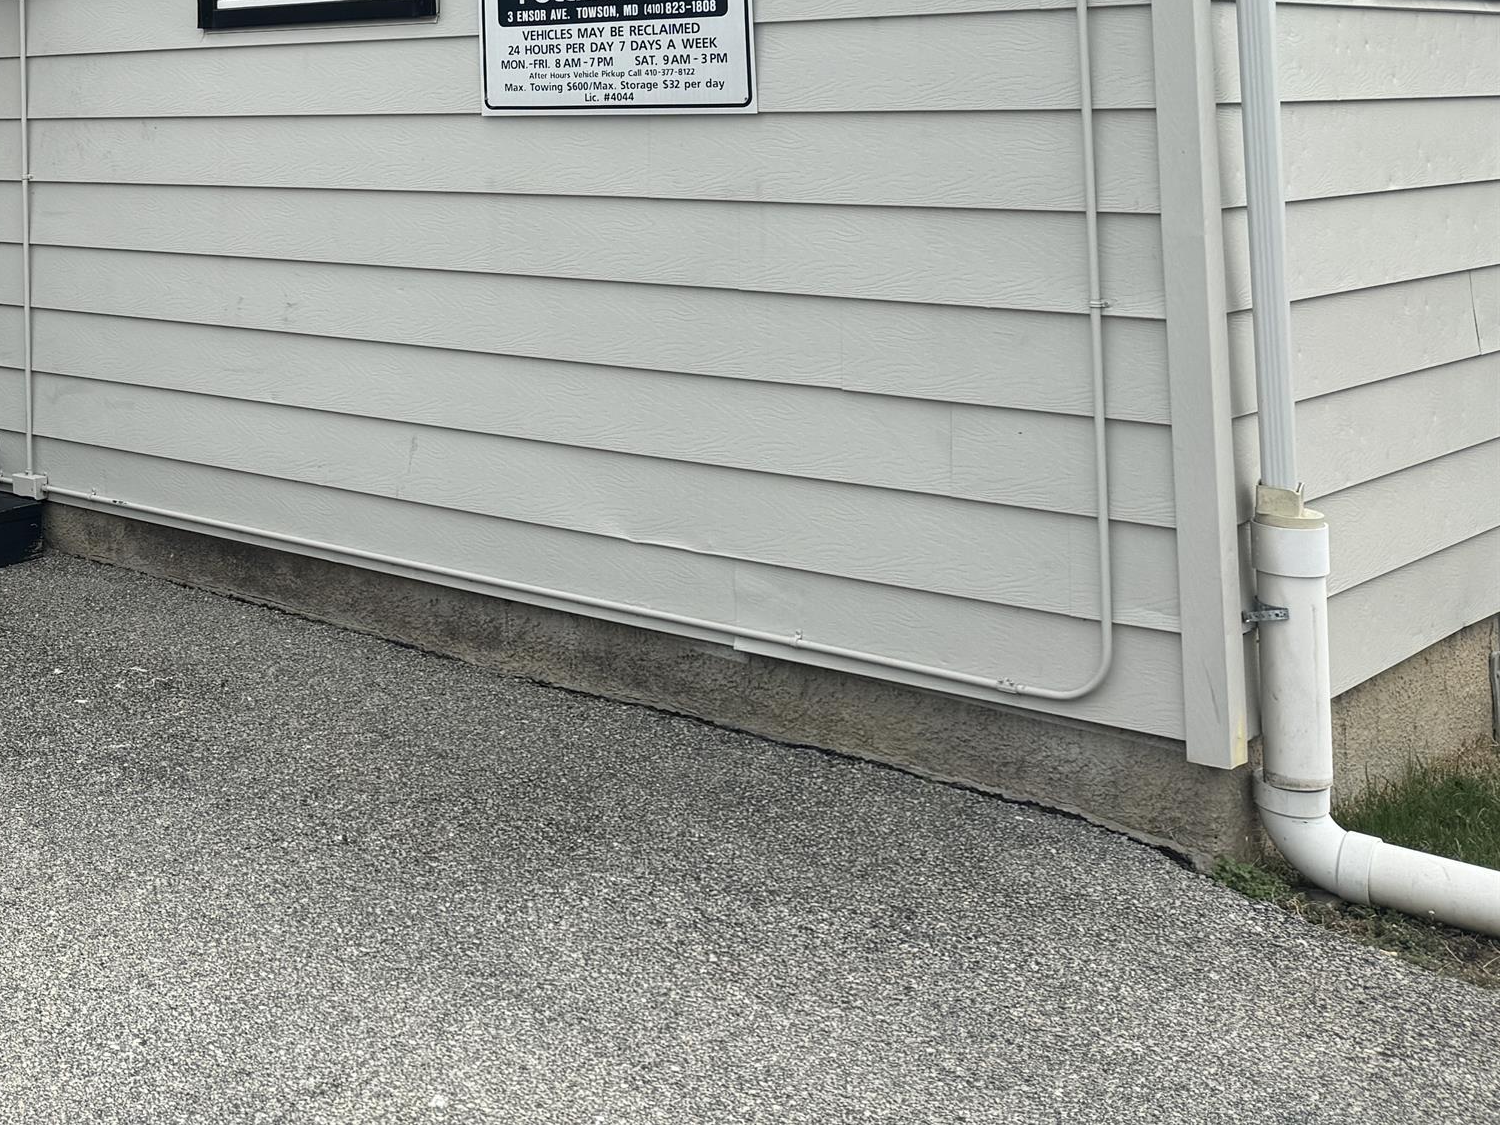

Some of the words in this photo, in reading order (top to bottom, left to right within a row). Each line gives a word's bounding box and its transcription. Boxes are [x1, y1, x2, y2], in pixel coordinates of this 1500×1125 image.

[507, 11, 514, 23] 3
[516, 9, 547, 22] ENSOR
[550, 8, 571, 21] AVE.
[576, 5, 620, 19] TOWSON,
[623, 4, 639, 16] MD
[522, 28, 573, 41] VEHICLES
[577, 27, 605, 39] MAY
[610, 26, 624, 37] BE
[629, 22, 701, 36] RECLAIMED
[508, 45, 521, 56] 24
[525, 43, 561, 55] HOURS
[565, 42, 586, 53] PER
[590, 41, 614, 52] DAY
[619, 40, 626, 51] 7
[630, 39, 662, 51] DAYS
[666, 39, 677, 50] A
[681, 37, 718, 49] WEEK
[634, 55, 658, 66] SAT.
[529, 72, 547, 80] After
[550, 71, 571, 79] Hours
[573, 70, 599, 78] Vehicle
[601, 70, 625, 79] Pickup
[628, 69, 642, 77] Call
[644, 68, 696, 76] 410-377-8122
[504, 83, 527, 92] Max.
[530, 82, 563, 94] Towing
[567, 81, 616, 91] $600/Max.
[620, 80, 659, 92] Storage
[662, 80, 680, 89] $32
[684, 80, 701, 91] per
[705, 78, 725, 90] day
[584, 92, 600, 103] Lic.
[603, 92, 635, 102] #4044
